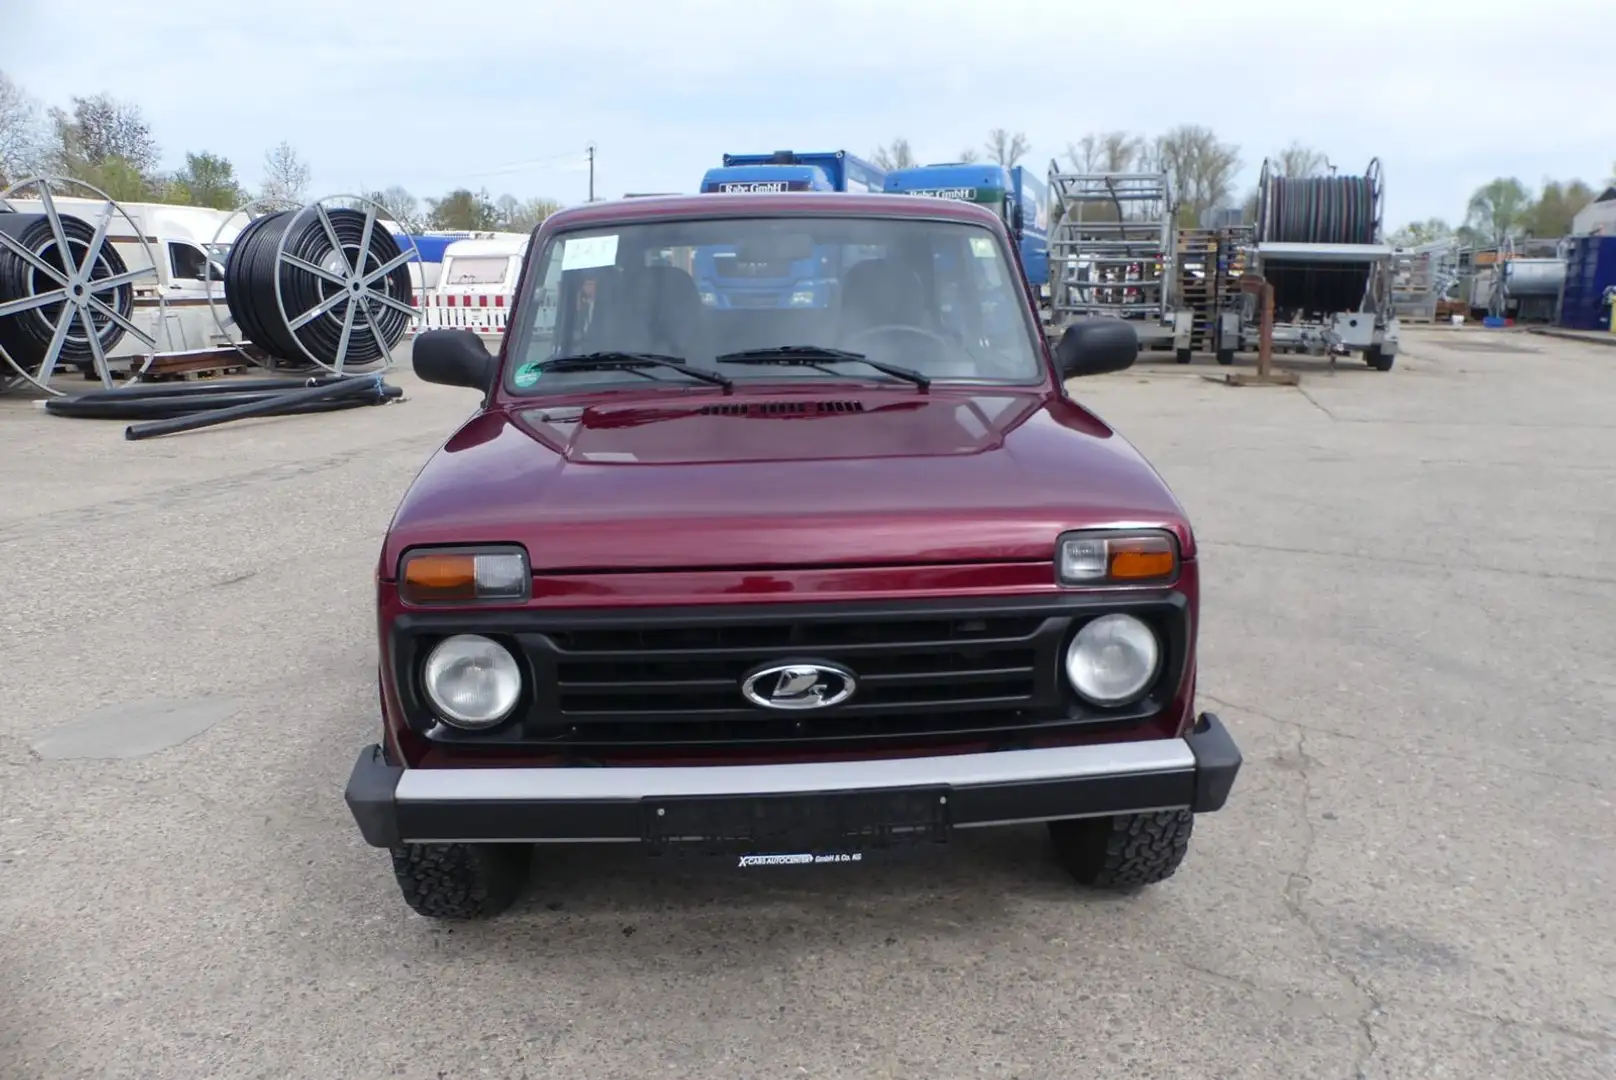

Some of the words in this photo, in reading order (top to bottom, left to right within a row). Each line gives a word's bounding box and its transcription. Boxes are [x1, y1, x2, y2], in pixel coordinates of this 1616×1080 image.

[750, 183, 781, 194] GmbH
[936, 188, 969, 198] GmbH
[815, 855, 834, 863] GmbH
